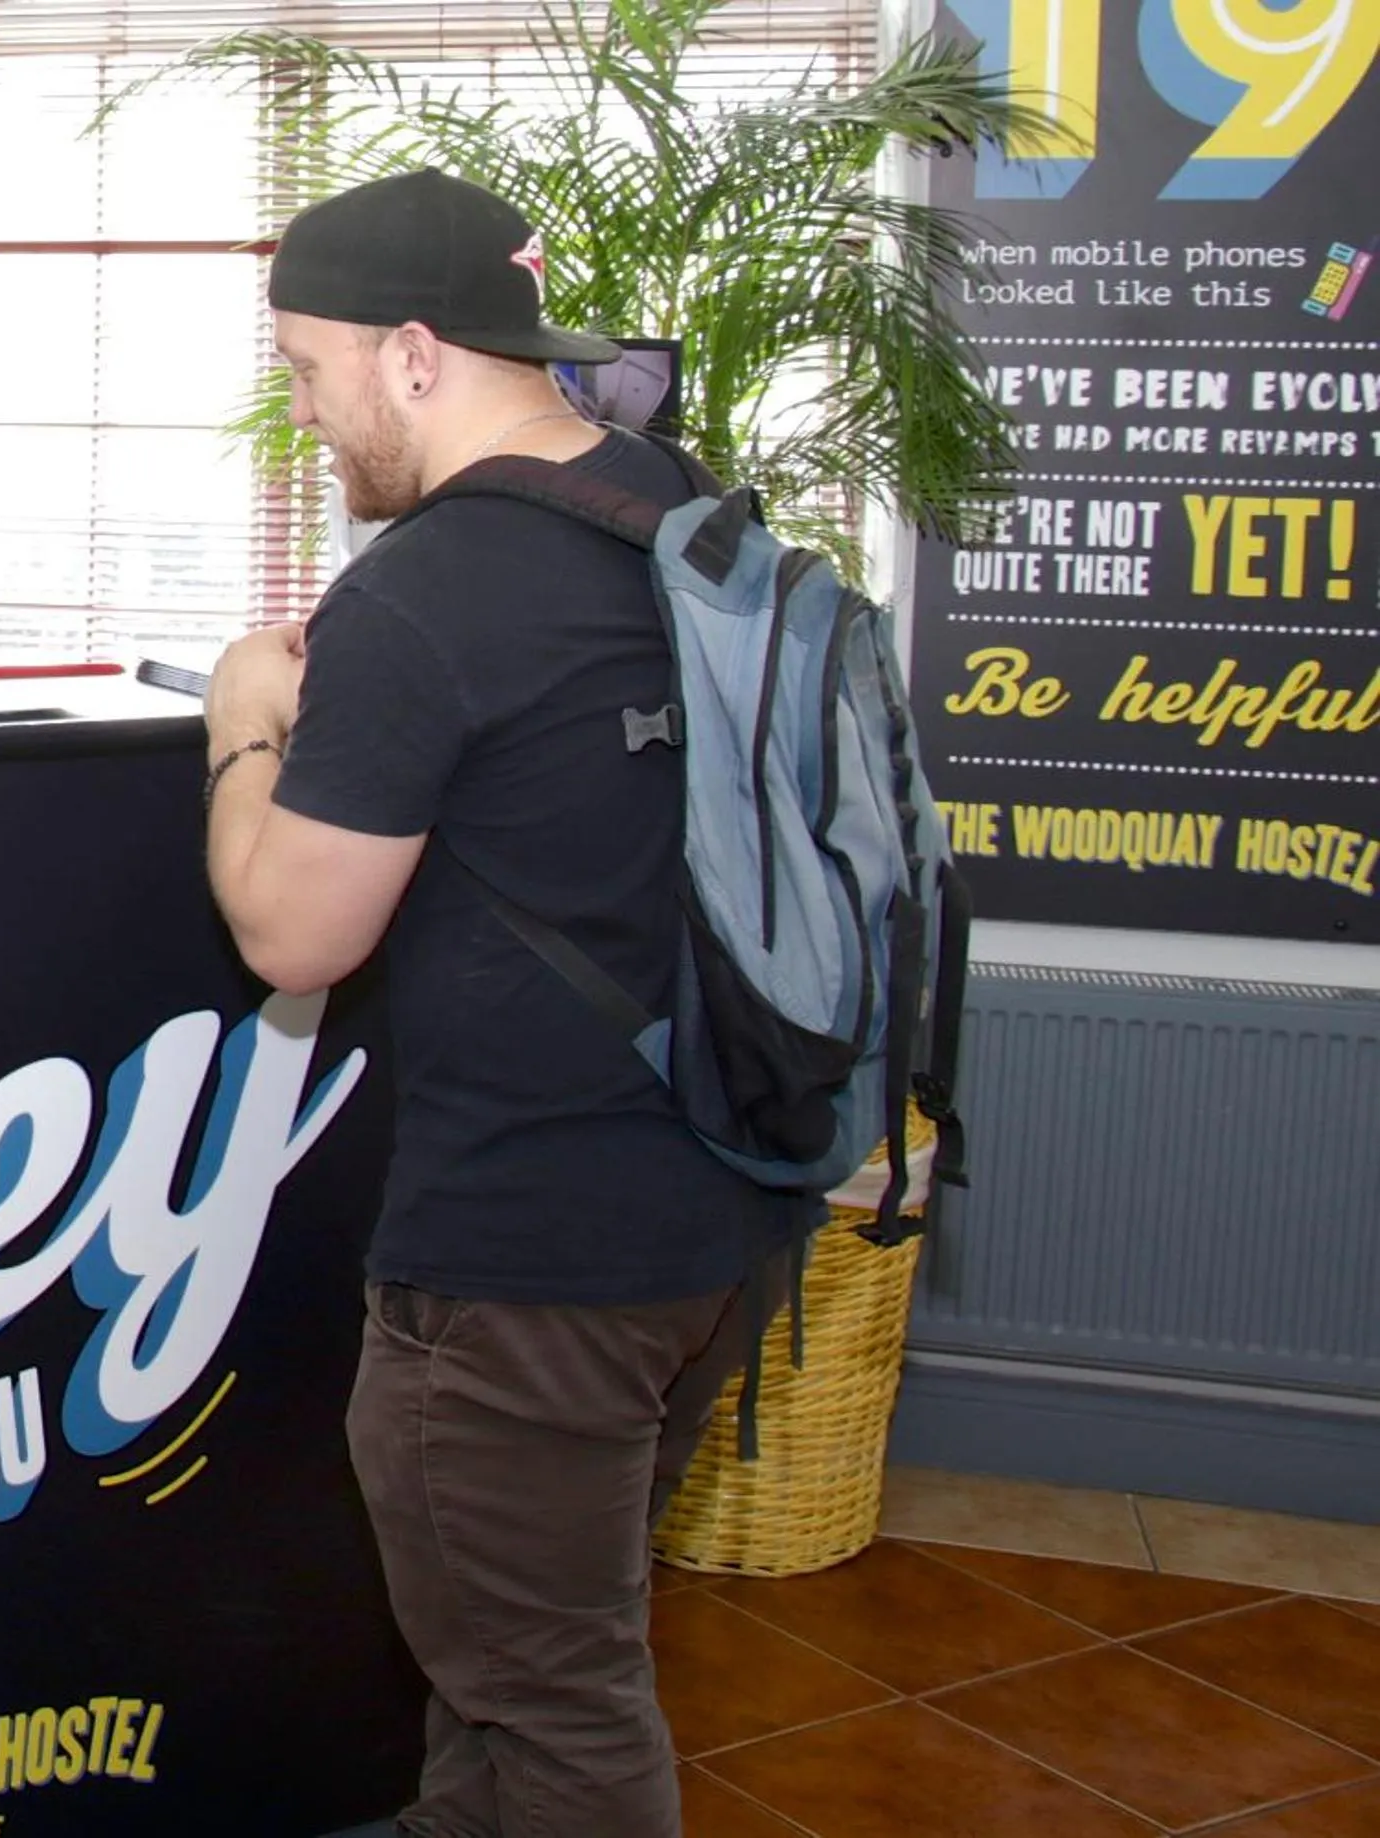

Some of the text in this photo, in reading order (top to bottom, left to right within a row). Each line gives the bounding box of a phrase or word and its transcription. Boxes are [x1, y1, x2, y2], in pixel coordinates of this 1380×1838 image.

[958, 239, 1306, 272] when mobile phones
[961, 280, 1271, 307] looked like this
[1114, 367, 1229, 410] BEEN
[1054, 424, 1112, 452] HAD
[1125, 426, 1208, 454] MORE
[1221, 428, 1357, 457] REVAMPS
[1087, 500, 1161, 548] NOT
[1183, 494, 1356, 600] YET!
[953, 550, 1150, 597] QUITE THERE
[945, 647, 1380, 748] Be helpful
[1012, 805, 1222, 871] WOODQUAY
[1236, 818, 1380, 896] HOSTEL
